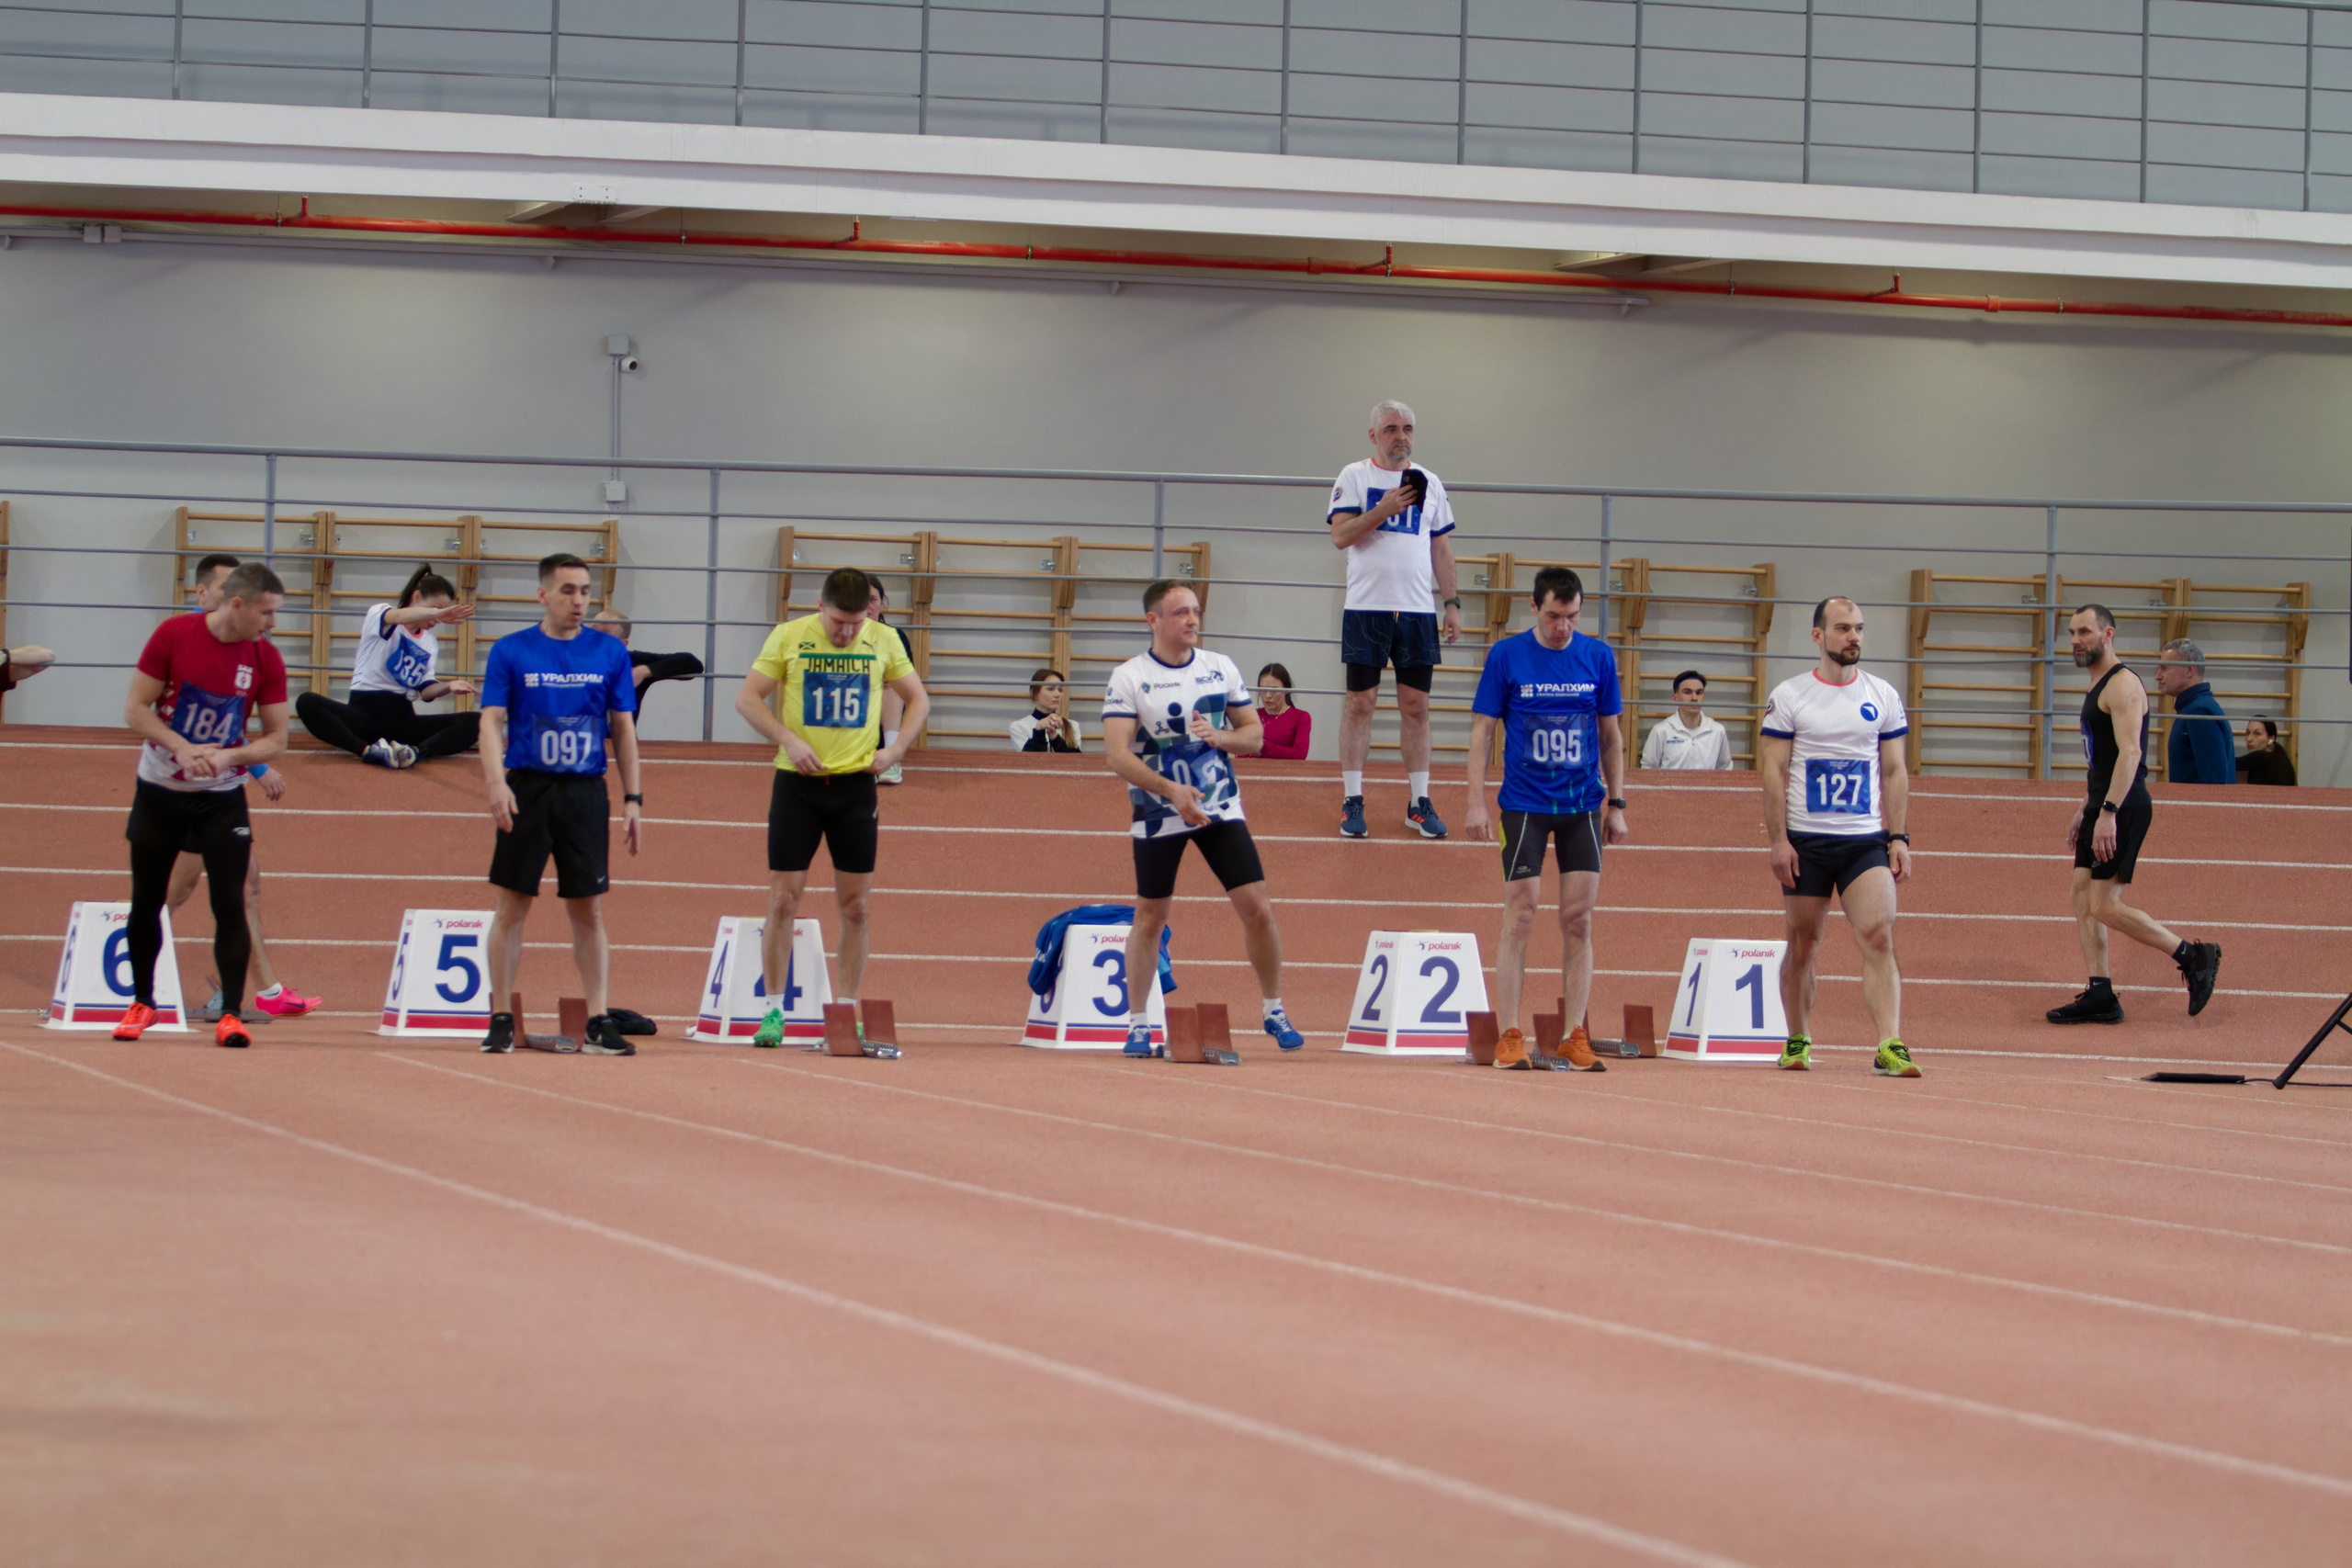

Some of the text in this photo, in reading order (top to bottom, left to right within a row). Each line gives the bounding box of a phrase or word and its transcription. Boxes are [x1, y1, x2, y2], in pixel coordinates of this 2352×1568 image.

[393, 649, 425, 687] 135
[541, 672, 604, 683] УРАЛХИМ
[808, 658, 870, 672] JAMAICA
[812, 686, 860, 721] 115
[1536, 683, 1595, 692] УРАЛХИМ
[182, 703, 234, 745] 184
[541, 730, 592, 765] 097
[1532, 729, 1581, 762] 095
[1816, 773, 1862, 806] 127
[446, 919, 482, 929] polanik
[1428, 942, 1461, 951] polanik
[1741, 949, 1775, 958] polanik
[392, 932, 410, 1000] 5
[435, 934, 481, 1003] 5
[709, 941, 729, 1009] 4
[1092, 949, 1130, 1017] 3
[1361, 954, 1388, 1021] 2
[1419, 956, 1461, 1022] 2
[1686, 962, 1702, 1026] 1
[1736, 964, 1764, 1029] 1
